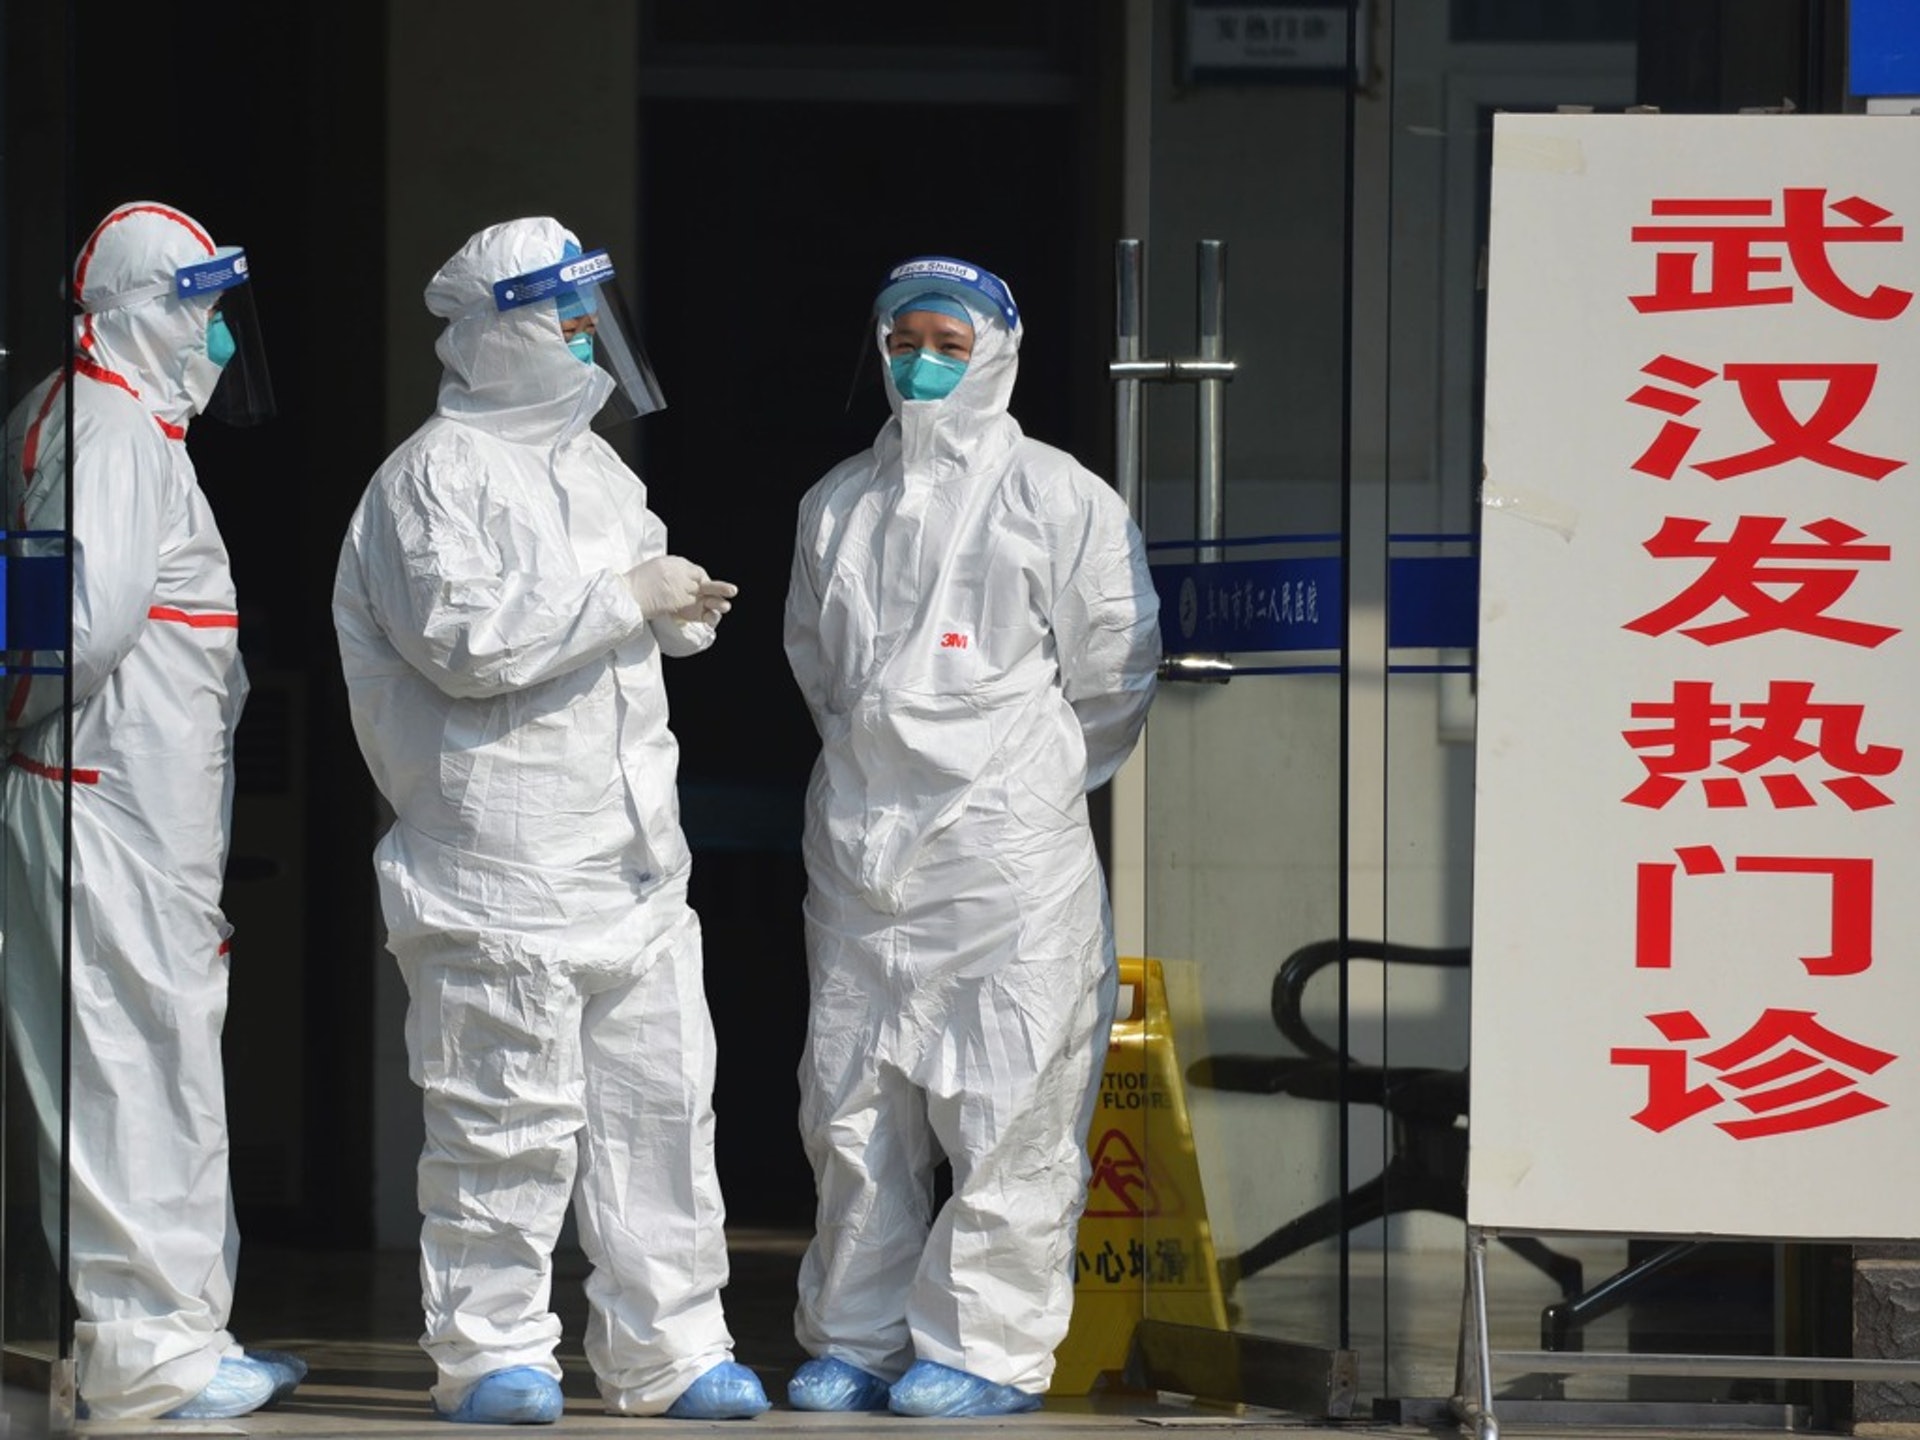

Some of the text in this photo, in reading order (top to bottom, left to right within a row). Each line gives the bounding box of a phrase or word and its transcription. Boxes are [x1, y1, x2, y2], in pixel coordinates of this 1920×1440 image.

[898, 262, 968, 276] Face Shield
[940, 632, 968, 649] 3M
[1611, 188, 1913, 1140] 武汉发热门诊
